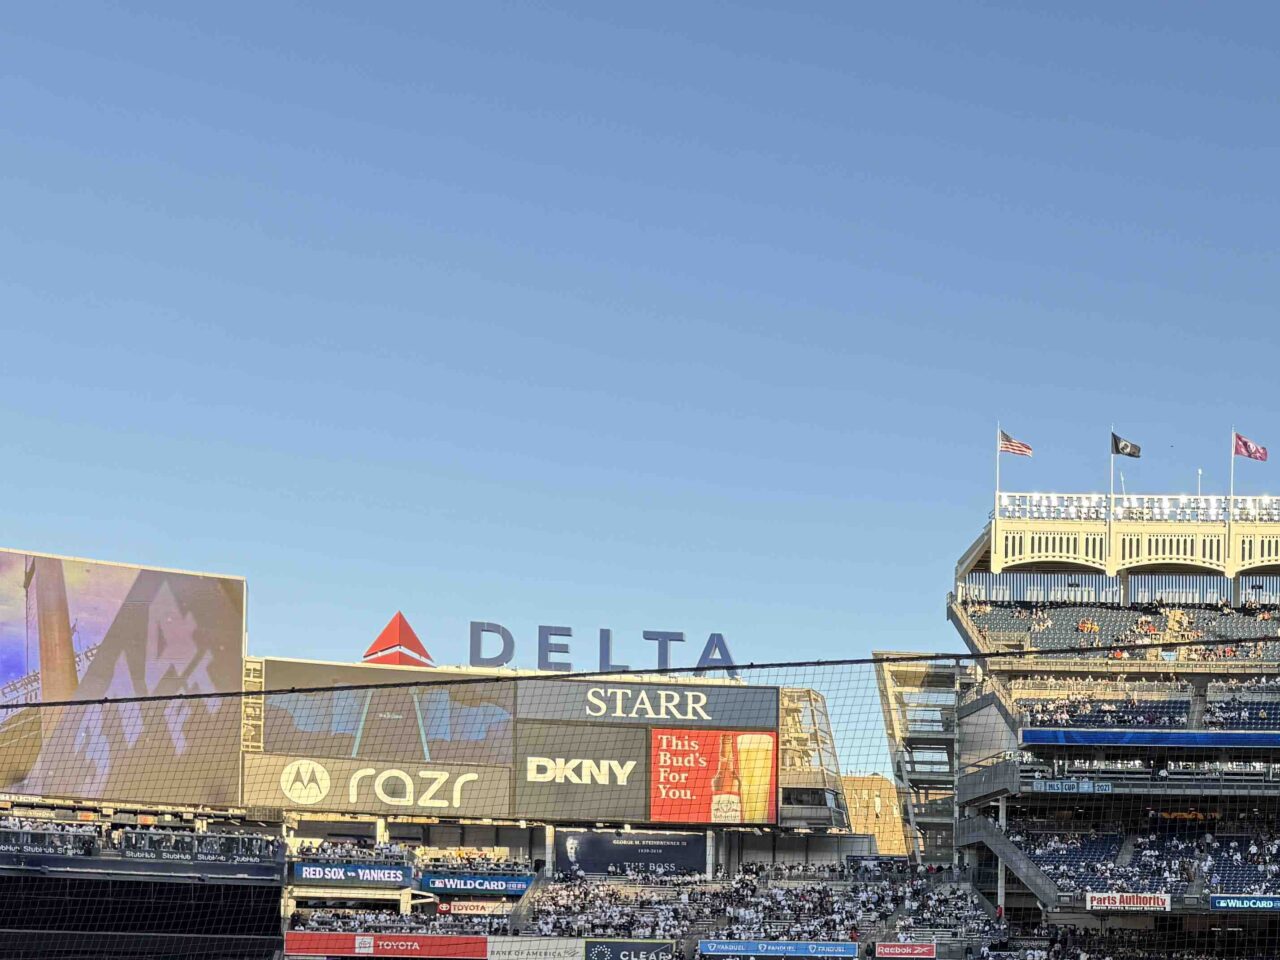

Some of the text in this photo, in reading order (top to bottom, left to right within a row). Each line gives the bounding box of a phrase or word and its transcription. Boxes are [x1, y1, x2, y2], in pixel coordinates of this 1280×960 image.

[469, 621, 741, 678] DELTA
[585, 688, 712, 720] STARR
[658, 735, 699, 750] This
[658, 752, 707, 767] Bud's
[526, 756, 637, 785] DKNY
[658, 768, 688, 783] For
[349, 768, 478, 808] razr
[658, 784, 697, 800] You.
[1048, 783, 1076, 791] MLS CUP
[1096, 784, 1110, 792] 2021
[302, 866, 403, 882] RED SOX YANKEES
[452, 904, 487, 912] TOYOTA
[1090, 895, 1166, 906] Parts Authority
[377, 940, 420, 950] TOYOTA
[878, 946, 912, 954] Reebok
